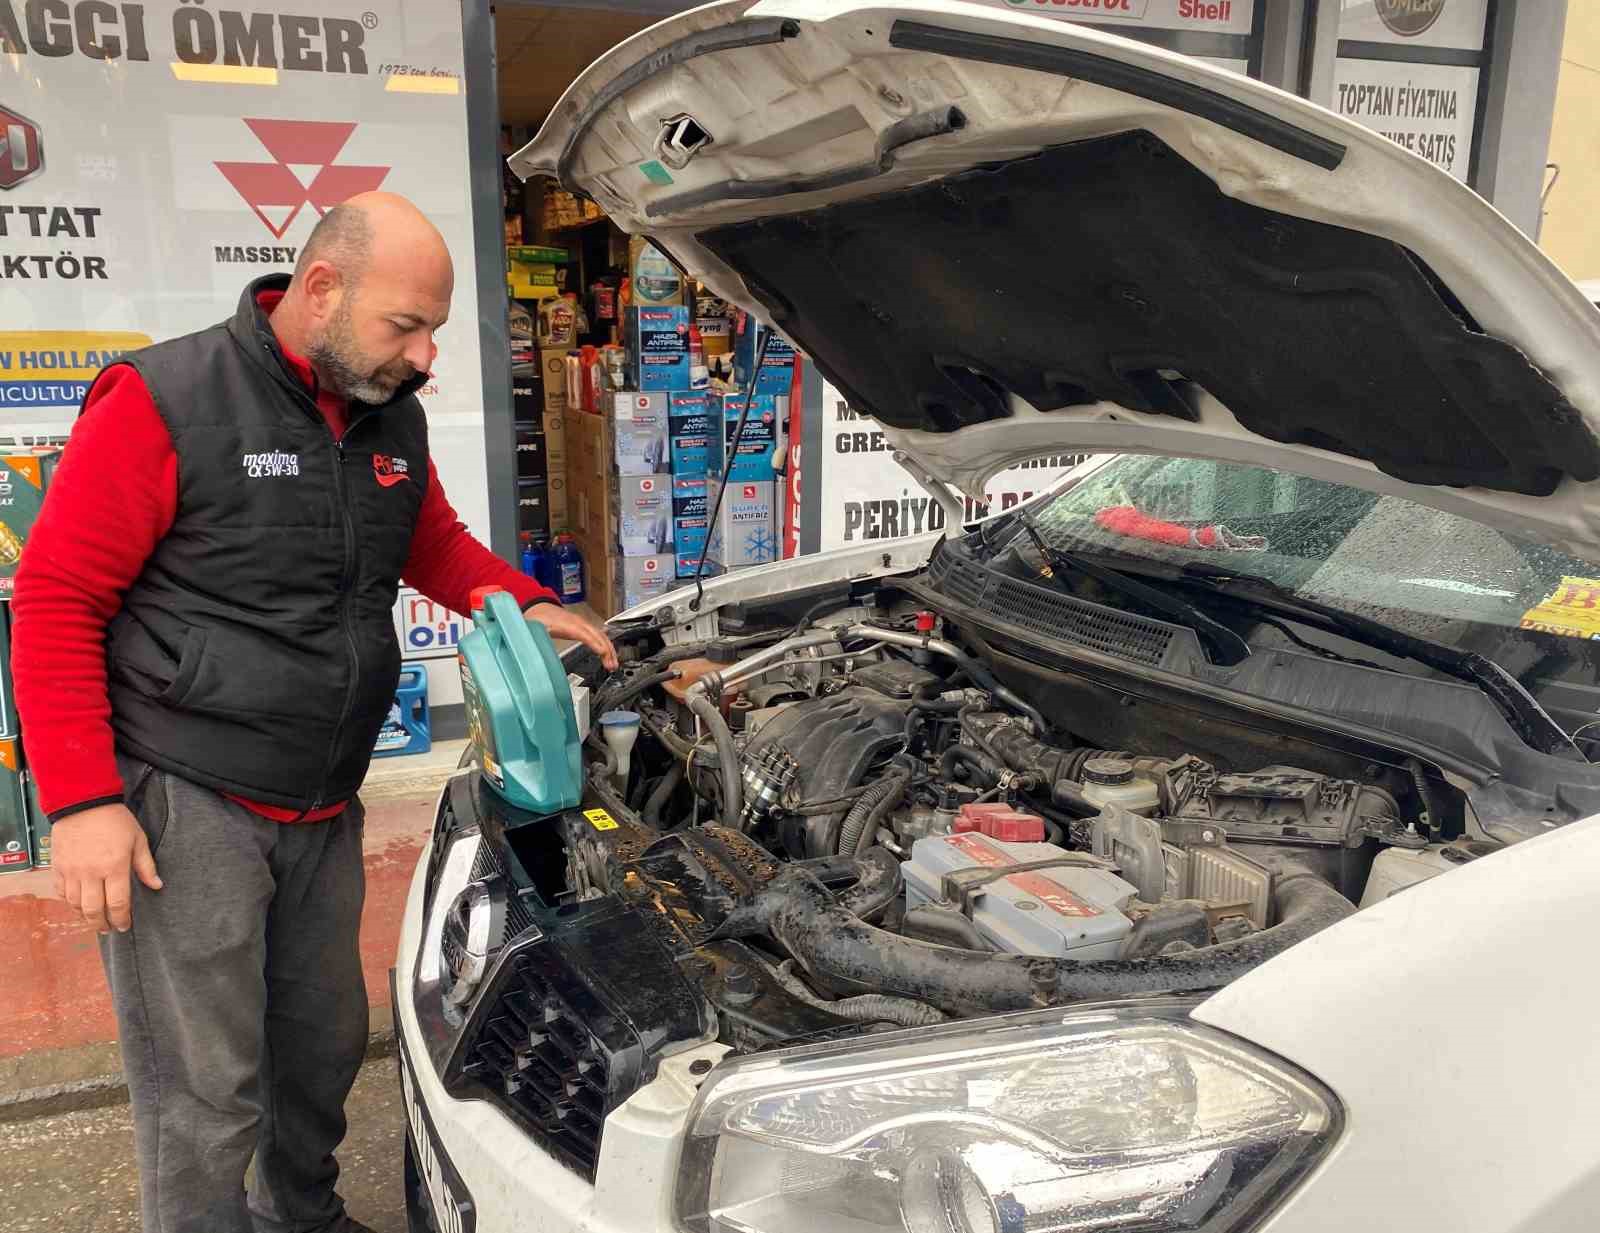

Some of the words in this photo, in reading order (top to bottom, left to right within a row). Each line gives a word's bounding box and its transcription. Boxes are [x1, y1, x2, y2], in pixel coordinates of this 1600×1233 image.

[1178, 0, 1231, 21] Shell
[172, 0, 369, 75] ÖMER
[1338, 84, 1394, 116] TOPTAN
[1397, 80, 1457, 119] FİYATINA
[1418, 133, 1456, 171] SATIŞ
[0, 251, 108, 280] KTÖR
[215, 246, 296, 264] MASSEY
[242, 449, 298, 468] maxima
[264, 464, 299, 477] 5W-30
[409, 622, 458, 648] oil
